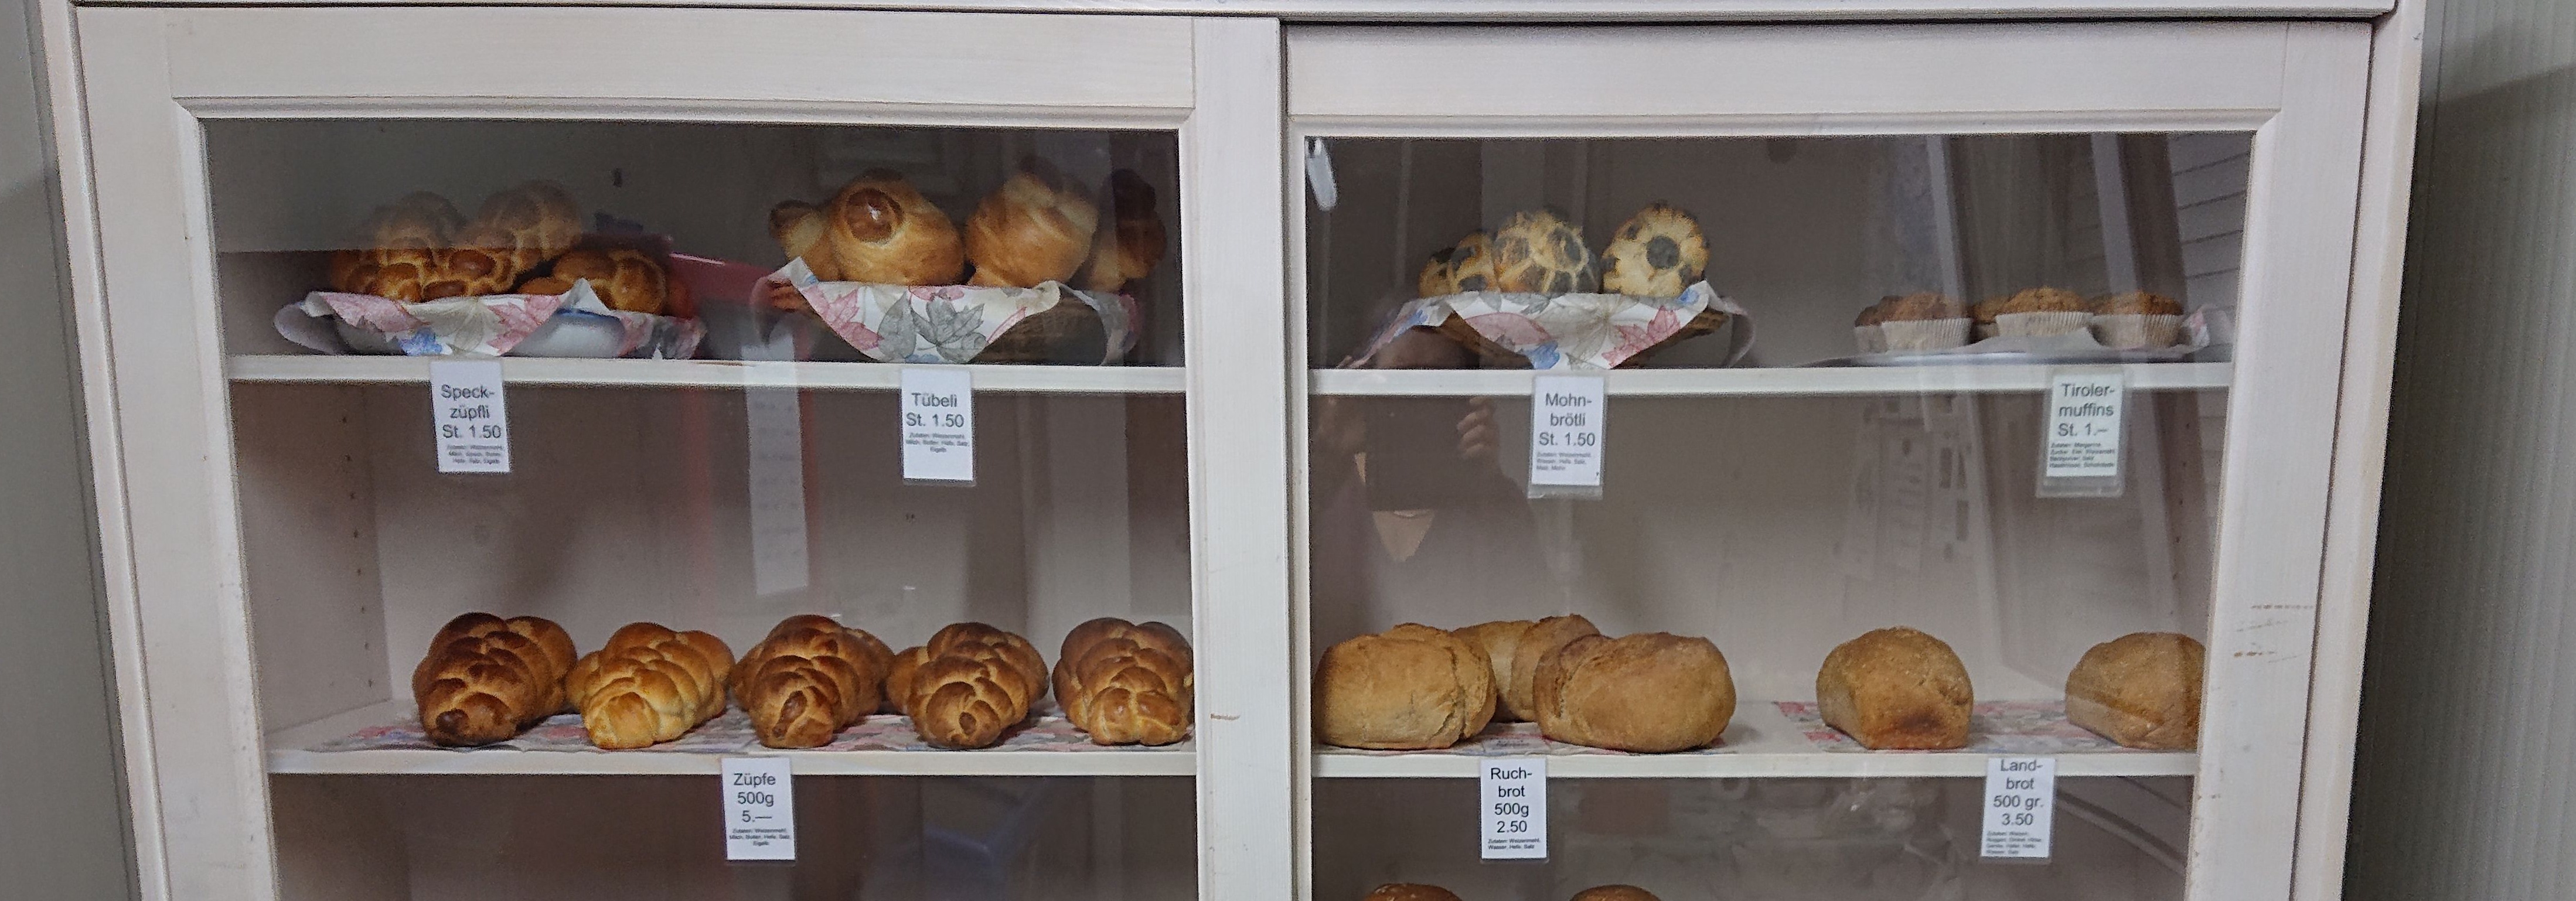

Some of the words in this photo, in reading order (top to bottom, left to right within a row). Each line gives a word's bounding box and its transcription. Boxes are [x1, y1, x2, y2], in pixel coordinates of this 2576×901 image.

[441, 384, 495, 401] Speck-
[2062, 383, 2115, 397] Tiroler-
[911, 392, 958, 407] Tübeli
[1545, 393, 1592, 407] Mohn-
[450, 404, 490, 421] züpfli
[2059, 403, 2114, 417] muffins
[907, 412, 926, 426] St.
[932, 414, 964, 428] 1.50
[1550, 412, 1585, 426] brötli
[469, 424, 502, 438] 1.50
[2058, 422, 2077, 436] St.
[1539, 432, 1558, 446] St.
[1565, 432, 1596, 446] 1.50
[2001, 759, 2043, 772] Land-
[733, 773, 776, 787] Züpfe
[1491, 767, 1532, 780] Ruch-
[2006, 777, 2035, 790] brot
[1498, 786, 1525, 797] brot
[737, 791, 774, 807] 500g
[1993, 795, 2020, 808] 500
[2025, 797, 2044, 811] gr.
[1495, 803, 1529, 818] 500g
[1497, 820, 1527, 833] 2.50
[2002, 813, 2033, 826] 3.50
